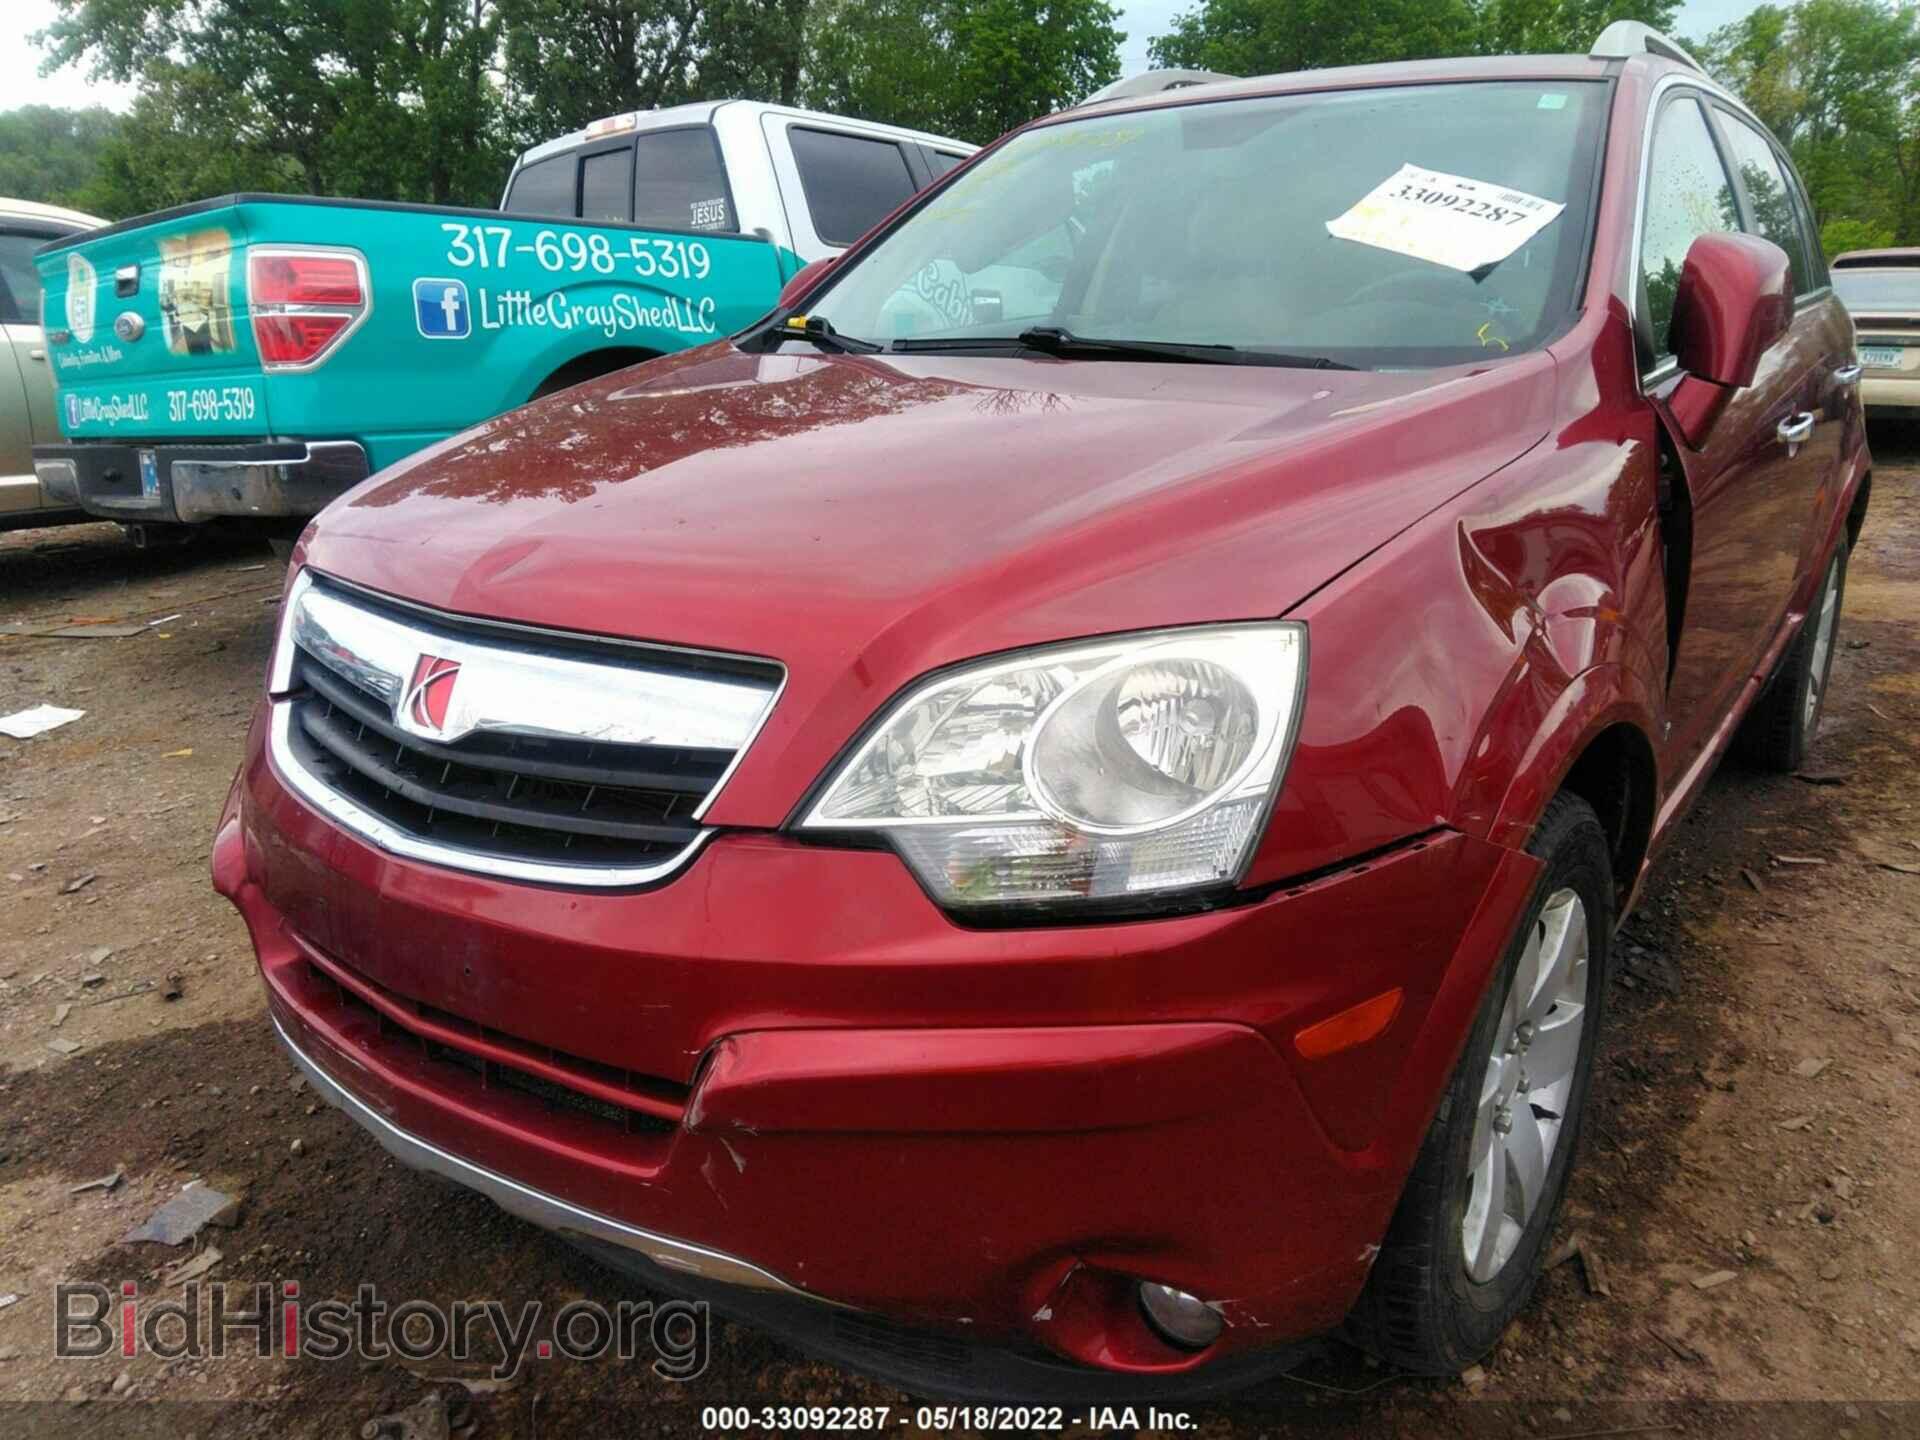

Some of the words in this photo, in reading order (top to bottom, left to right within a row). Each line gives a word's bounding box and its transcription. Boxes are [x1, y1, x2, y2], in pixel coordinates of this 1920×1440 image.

[691, 204, 724, 225] JESUS
[1390, 184, 1527, 226] 33092287
[441, 223, 711, 279] 317-698-5319
[479, 288, 715, 337] LittleGrayShedLLC
[167, 387, 255, 421] 317-698-5319
